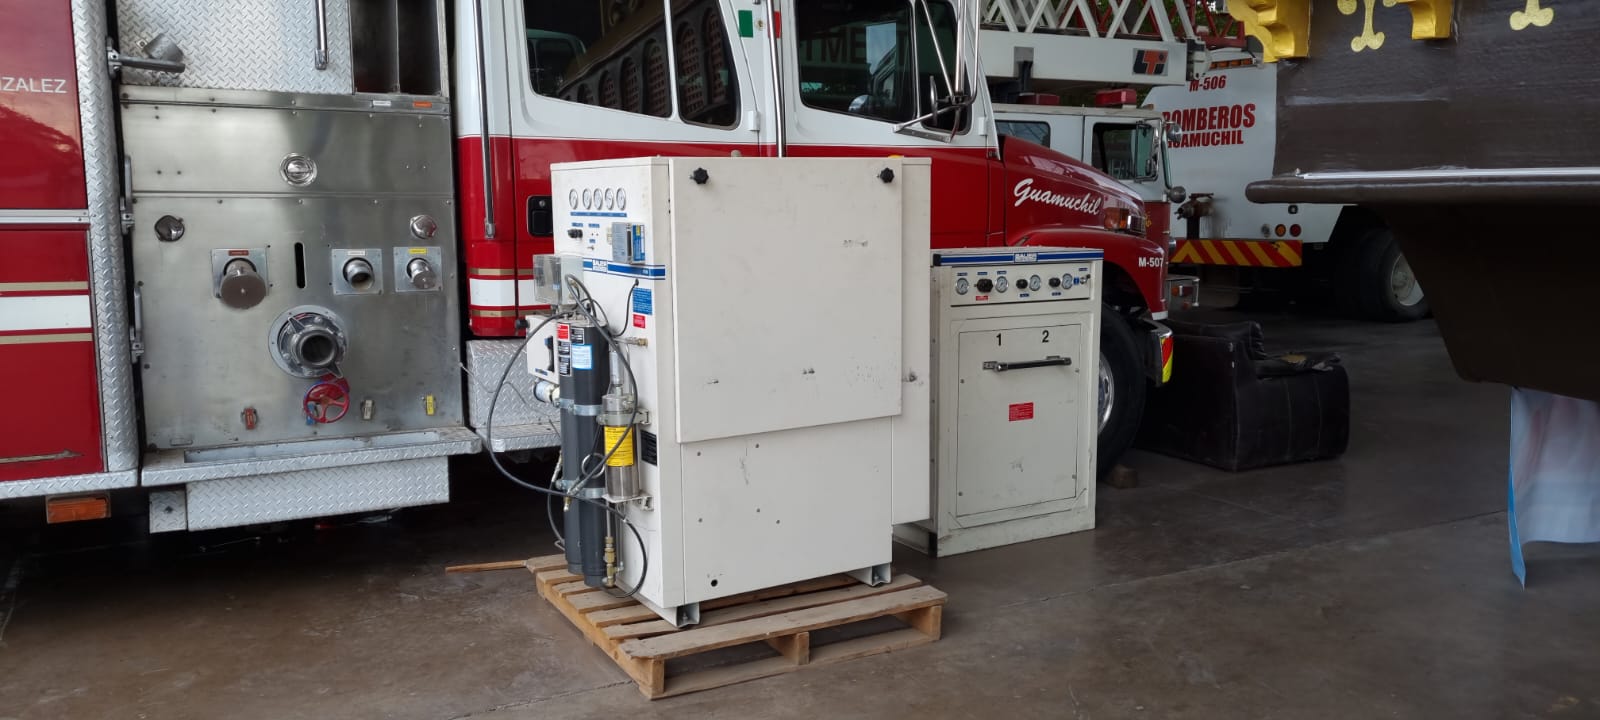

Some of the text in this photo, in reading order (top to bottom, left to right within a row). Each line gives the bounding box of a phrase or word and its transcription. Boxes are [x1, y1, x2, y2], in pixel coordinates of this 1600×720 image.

[0, 77, 67, 94] ZALEZ
[1189, 75, 1226, 92] M-506
[1014, 178, 1101, 216] Guamuchil
[1138, 256, 1164, 267] M-507
[996, 333, 1001, 346] 1
[1041, 330, 1049, 343] 2
